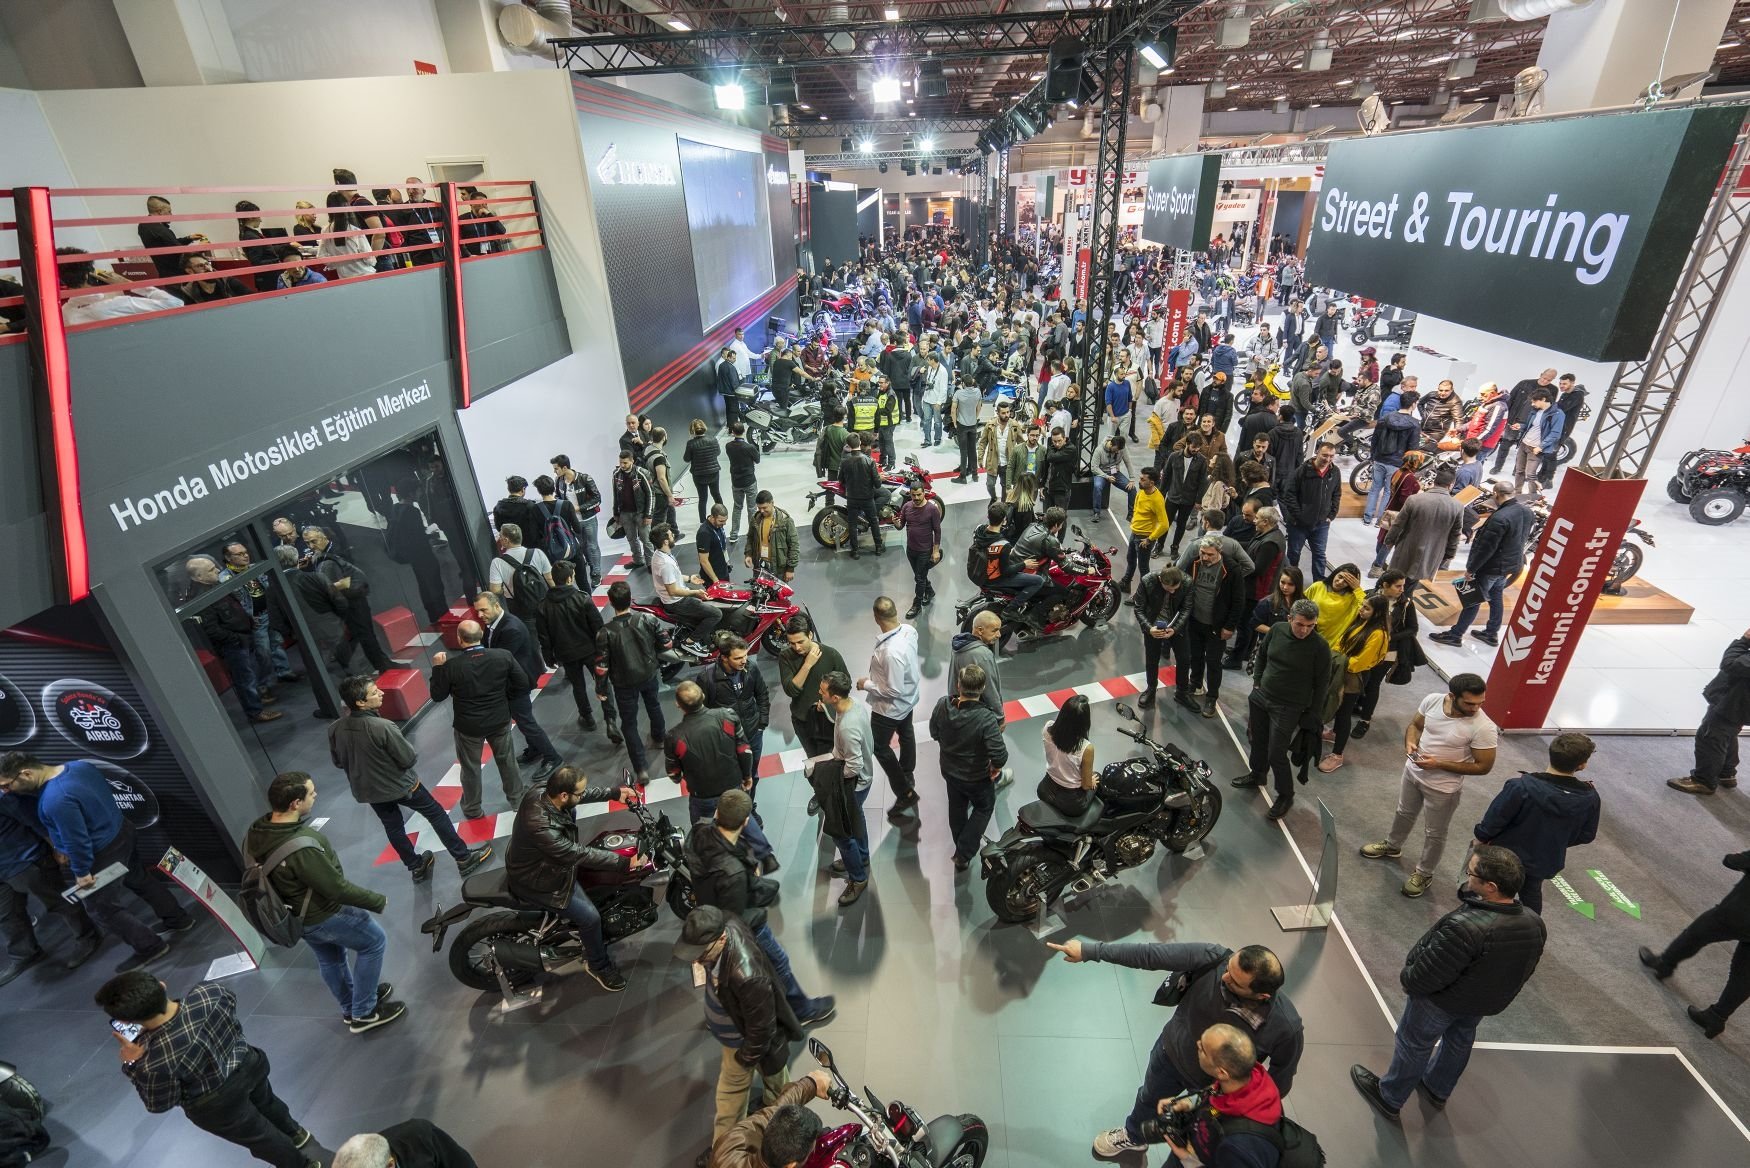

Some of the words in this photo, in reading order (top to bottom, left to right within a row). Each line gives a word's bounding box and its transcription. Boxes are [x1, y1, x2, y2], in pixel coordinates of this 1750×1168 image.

[1147, 185, 1169, 218] Super
[1170, 185, 1196, 220] Sport
[1322, 188, 1399, 240] Street
[1403, 191, 1430, 243] &
[1444, 191, 1630, 285] Touring
[1079, 261, 1087, 300] nuni.com.tr
[109, 476, 210, 532] Honda
[208, 425, 323, 490] Motosiklet
[321, 406, 377, 442] Eğitim
[376, 379, 432, 418] Merkezi
[1526, 527, 1611, 685] kanuni.com.tr
[85, 730, 125, 742] AIRBAG
[112, 793, 146, 802] NAHTAR
